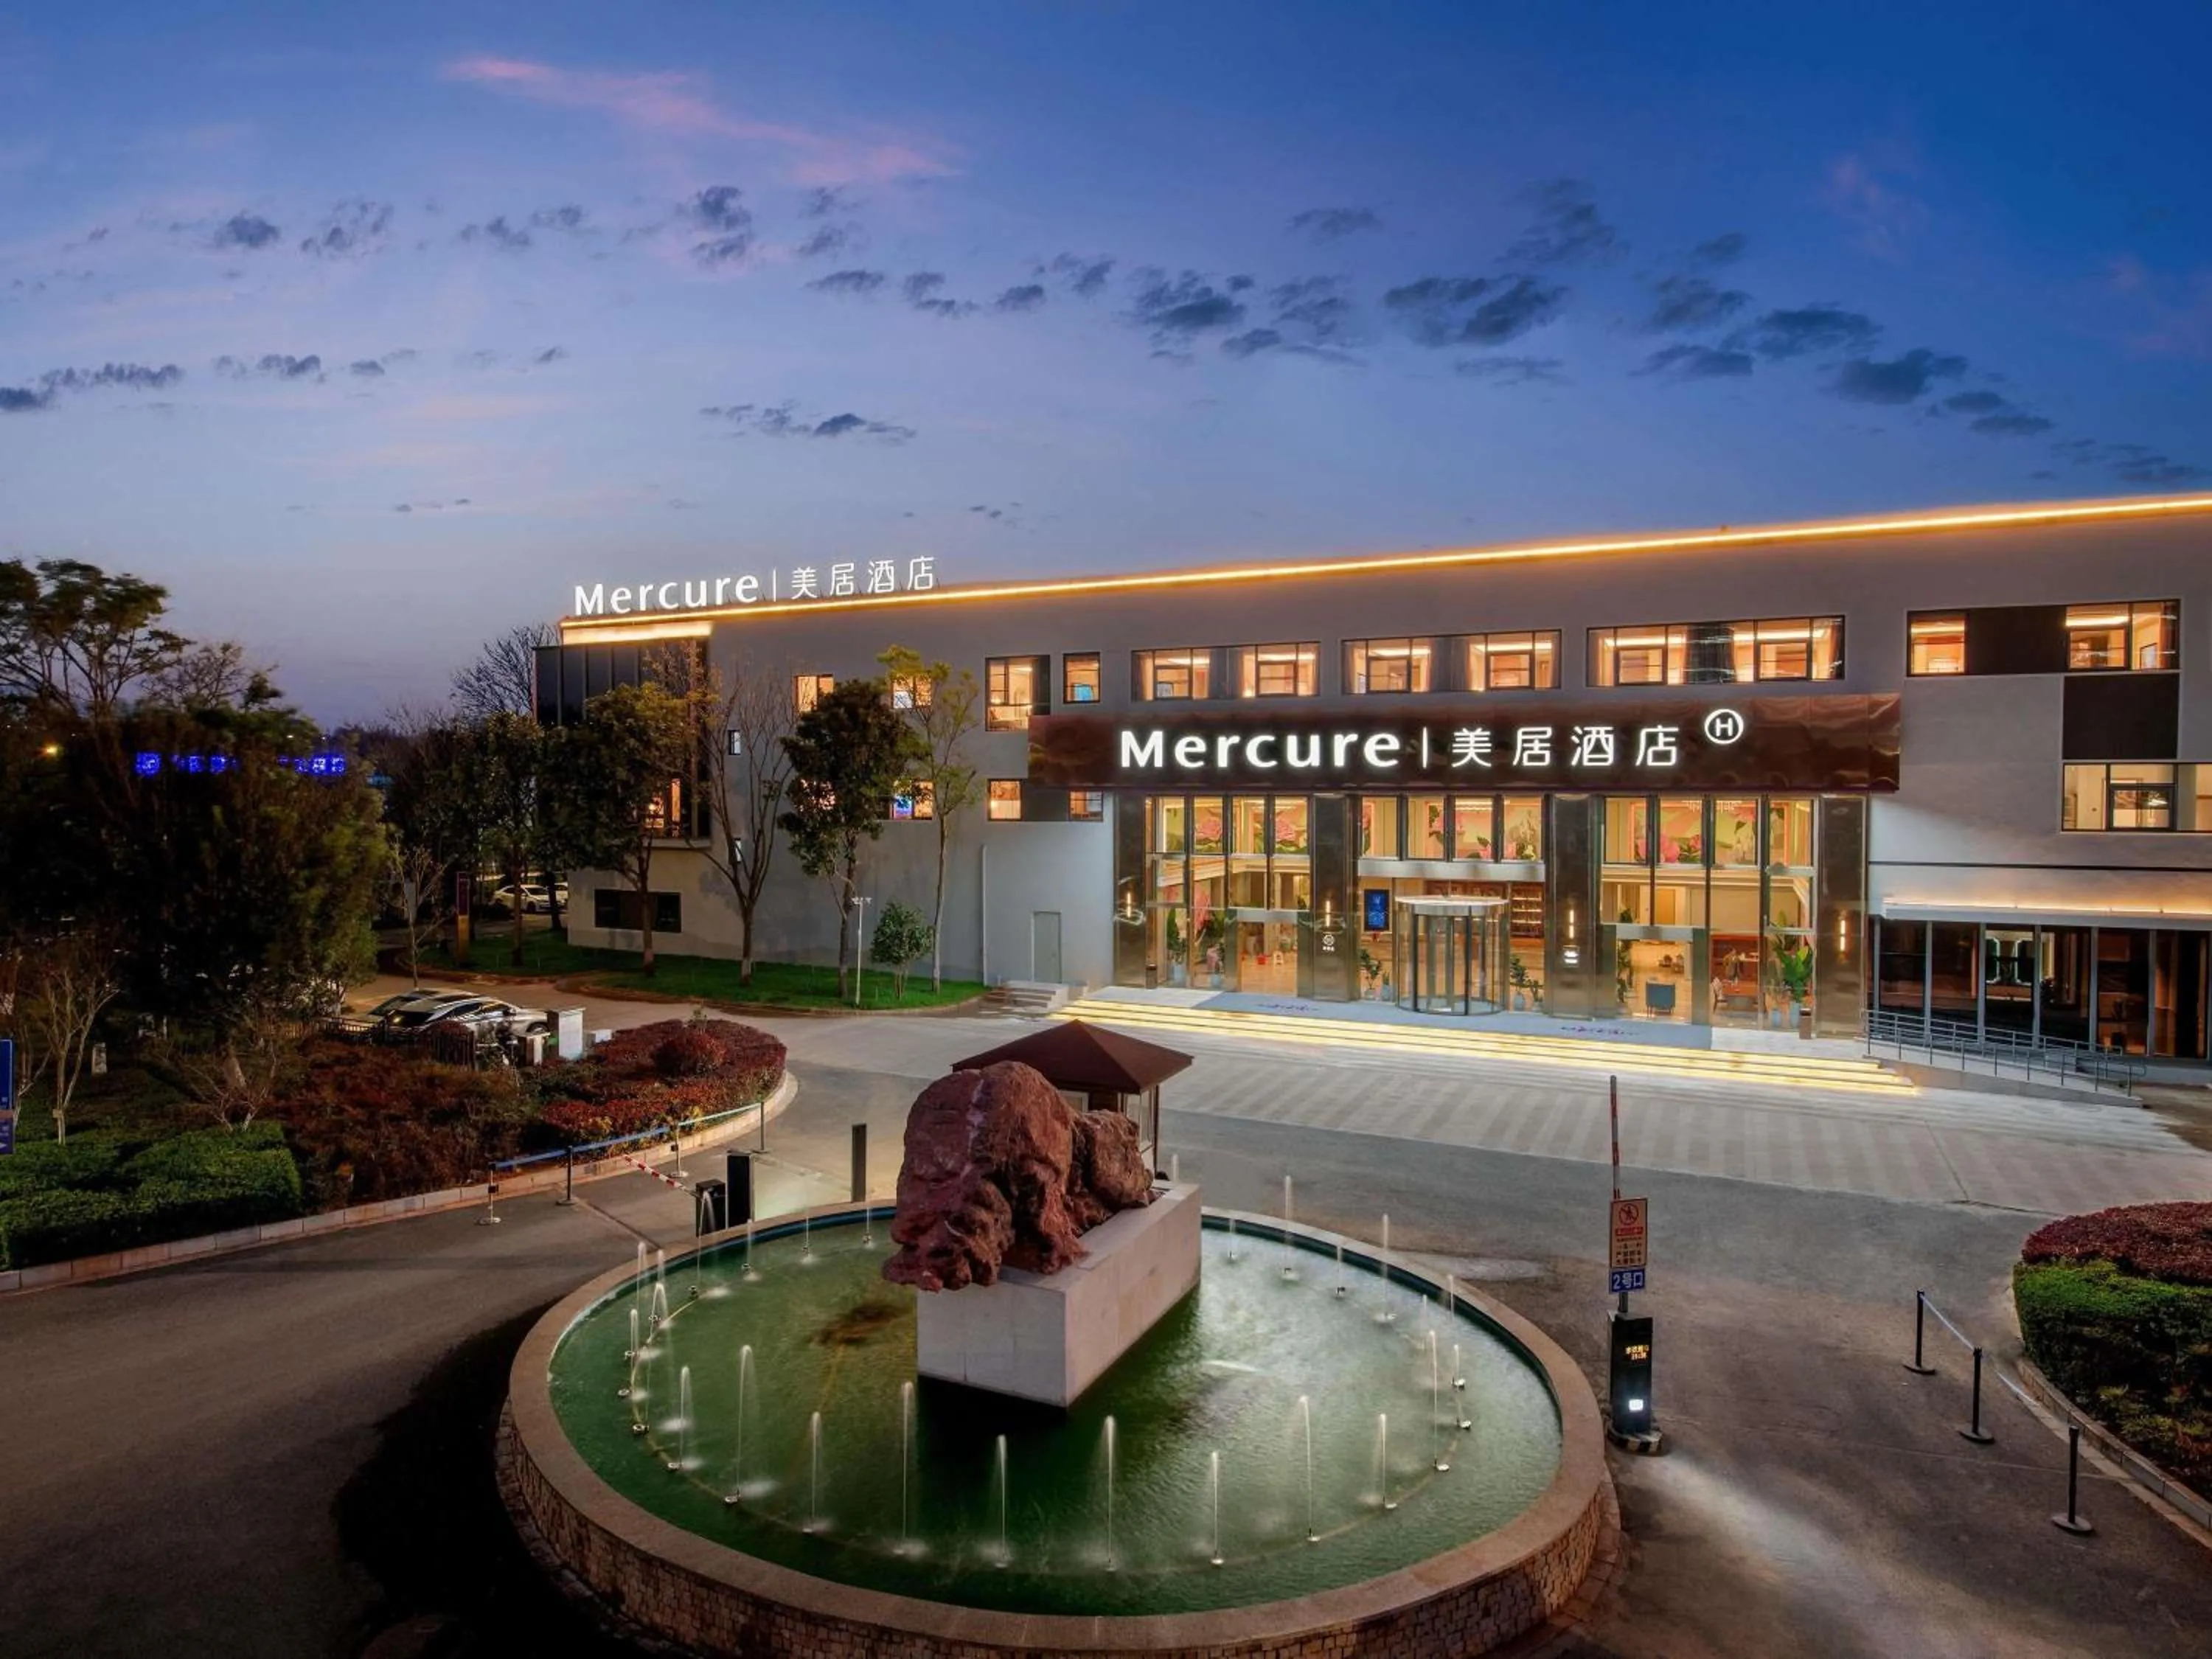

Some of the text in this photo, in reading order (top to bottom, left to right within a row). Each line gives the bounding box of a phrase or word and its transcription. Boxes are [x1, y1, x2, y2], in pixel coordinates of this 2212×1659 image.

[574, 574, 759, 616] Mercure
[790, 555, 936, 600] 美居酒店
[1119, 729, 1400, 768] Mercure
[1451, 724, 1680, 768] 美居酒店
[1613, 1272, 1644, 1290] 2号口
